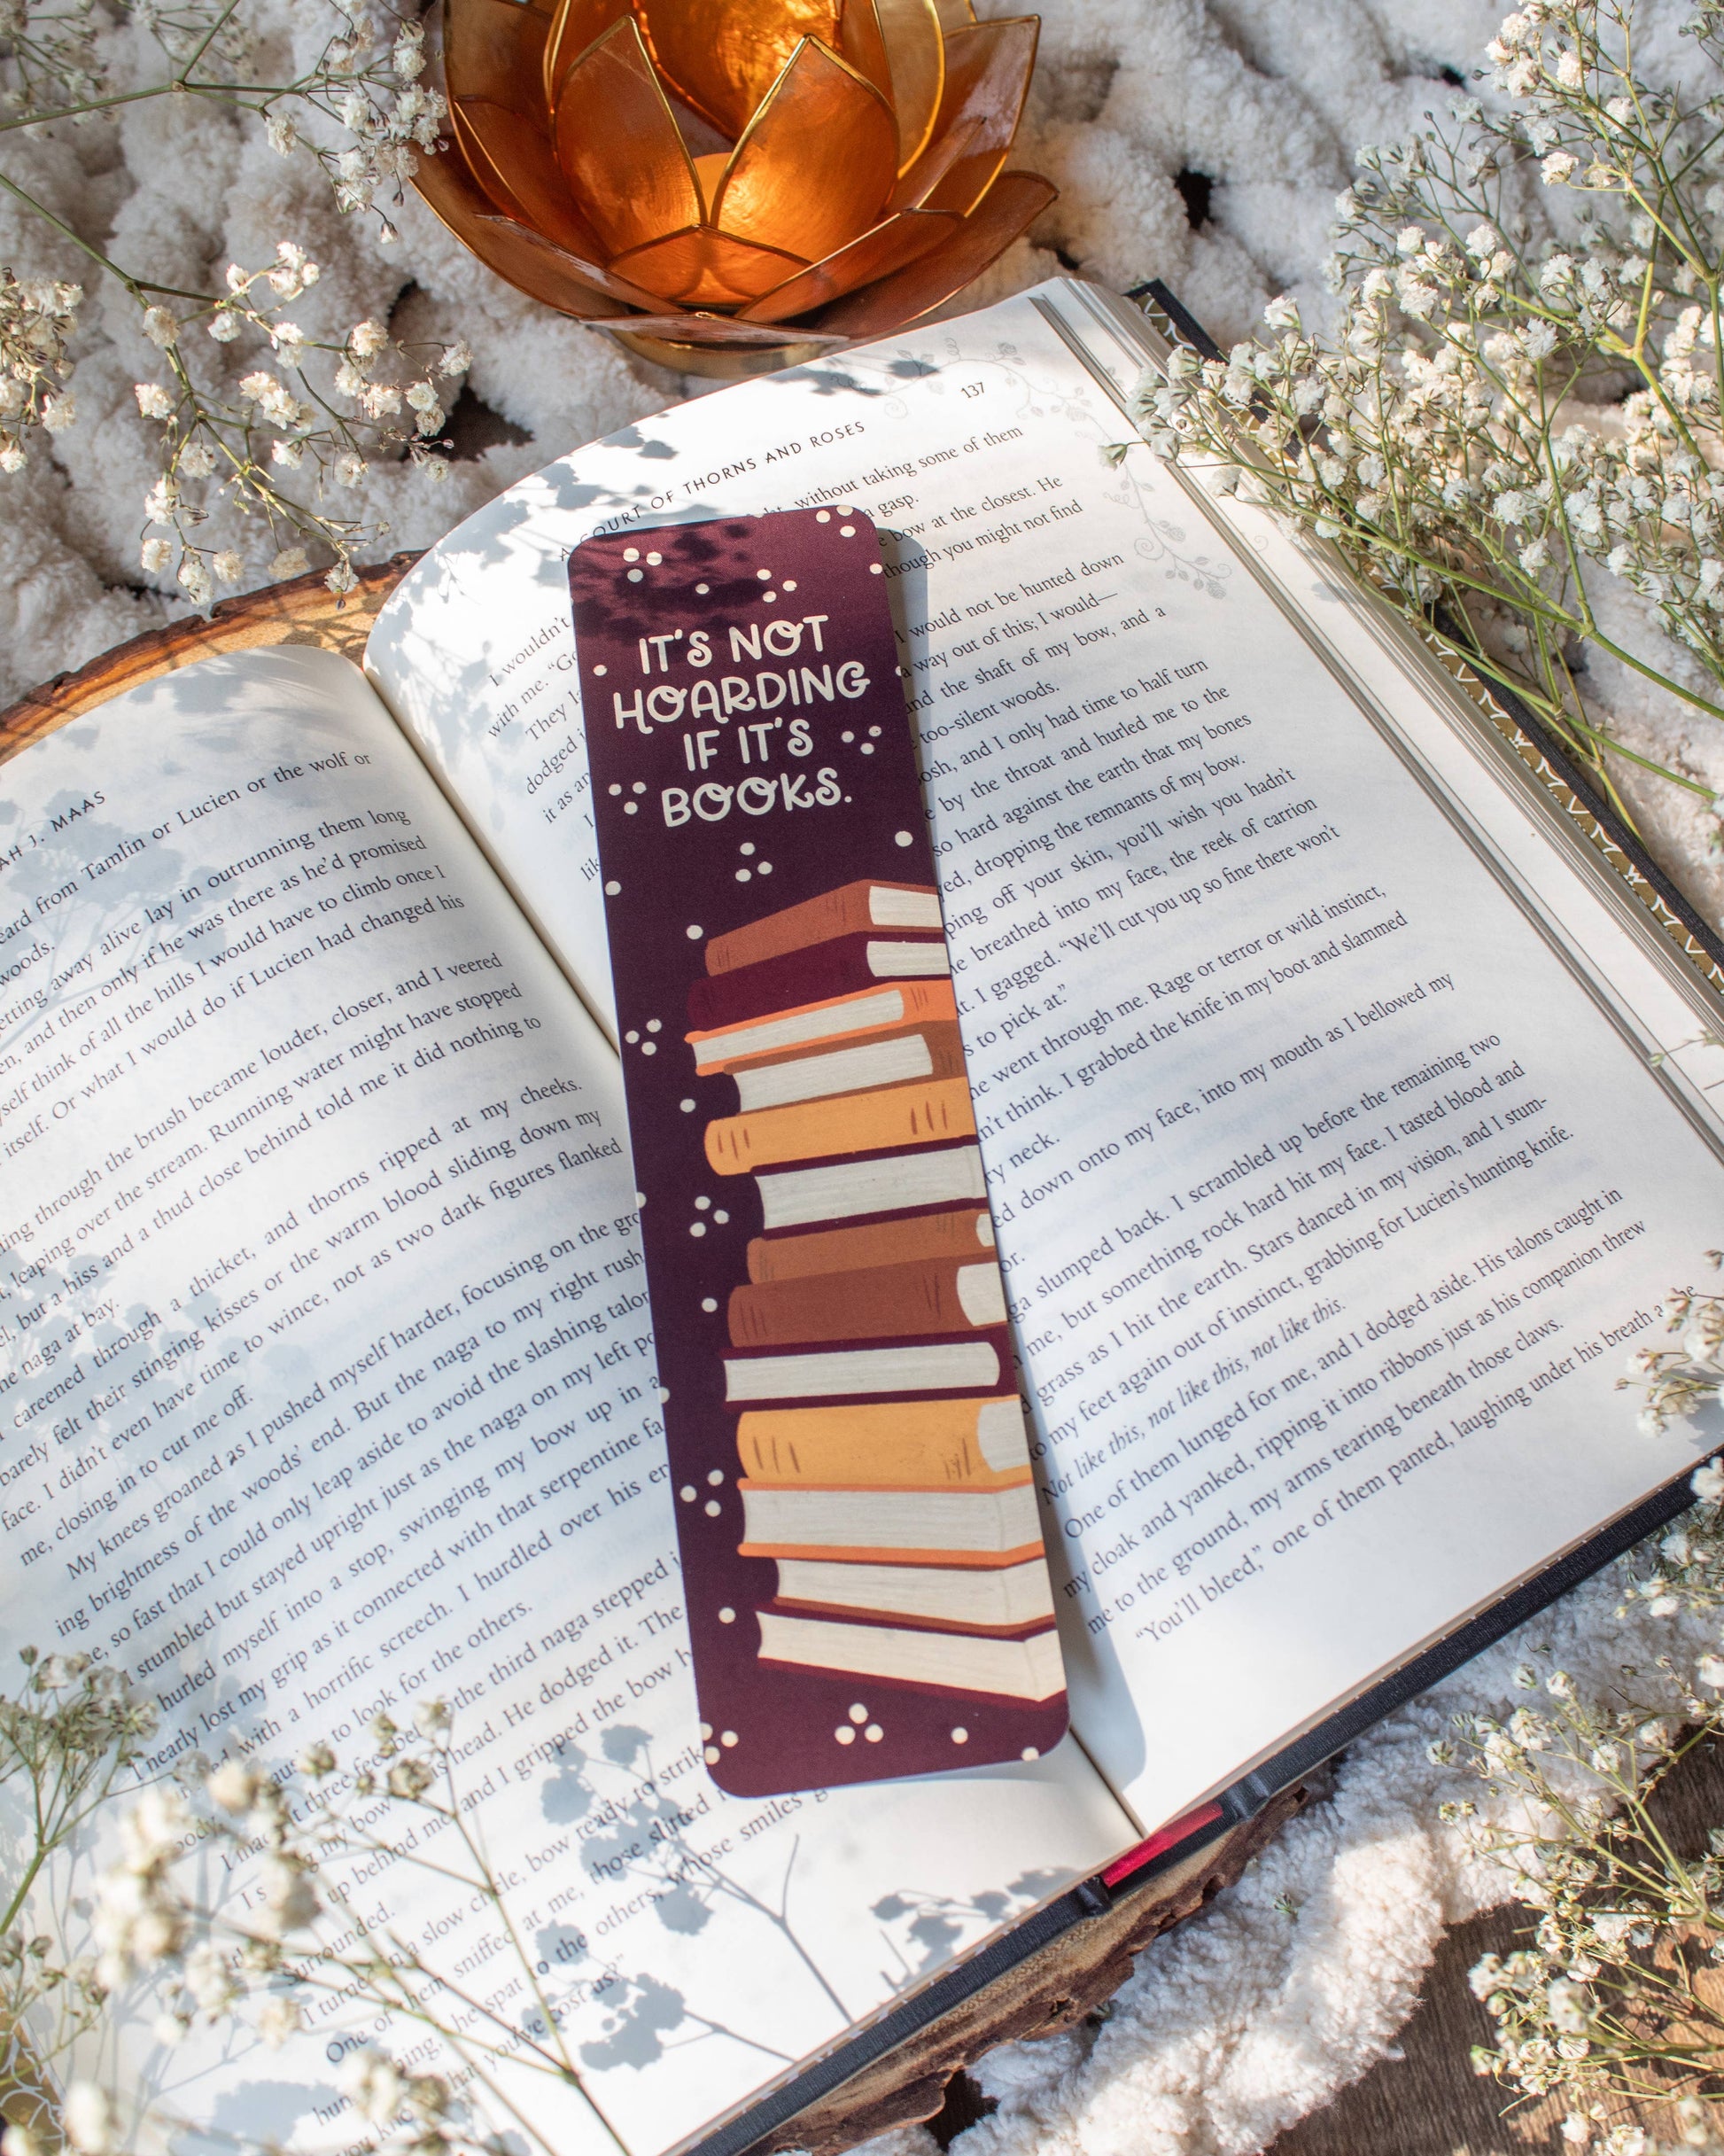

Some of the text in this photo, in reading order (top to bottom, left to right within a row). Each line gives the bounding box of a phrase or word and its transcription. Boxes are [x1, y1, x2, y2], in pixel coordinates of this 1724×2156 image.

[961, 382, 984, 398] 137
[650, 490, 674, 510] OF
[683, 458, 756, 494] THORNS
[765, 443, 801, 463] AND
[810, 422, 864, 447] ROSES
[794, 480, 859, 510] without
[862, 463, 917, 485] taking
[919, 448, 959, 467] some
[964, 437, 980, 453] of
[983, 428, 1023, 446] them
[878, 495, 919, 517] gasp.
[883, 499, 1083, 579] though you might not find
[888, 478, 1062, 541] bow at the closest. He
[489, 616, 571, 687] I wouldn't
[639, 615, 828, 674] IT'S NOT
[901, 666, 912, 678] a
[912, 652, 948, 671] way
[952, 640, 981, 657] out
[982, 627, 1000, 645] of
[1002, 619, 1038, 638] this;
[1036, 611, 1049, 625] I
[489, 681, 548, 736] with me.
[525, 704, 566, 740] They
[613, 661, 871, 734] HOARDING
[920, 681, 1060, 743] too-silent woods.
[960, 661, 1208, 765] and I only had time to half turn
[527, 736, 578, 794] dodged
[683, 717, 813, 771] IF IT'S
[28, 791, 105, 847] J. MAAS
[662, 767, 852, 827] BOOKS.
[933, 715, 1251, 857] so hard against the earth that my bones
[36, 751, 371, 915] from Tamlin or Lucien or the wolf or
[993, 768, 1296, 908] off your skin, you'll wish you hadn't
[992, 886, 1386, 1082] went through me. Rage or terror or wild instinct,
[35, 953, 503, 1225] through the brush became louder, closer, and I veered
[66, 1225, 610, 1580] My knees groaned as I pushed myself harder, focusing on the
[1042, 1298, 1346, 1505] Not like this, not like this, not like this.
[1065, 1190, 1623, 1537] One of them lunged for me, and I dodged aside. His talons caught in
[1273, 1525, 1309, 1553] one
[1313, 1499, 1334, 1527] of
[1337, 1476, 1386, 1511] them
[1387, 1430, 1454, 1485] panted,
[1450, 1388, 1532, 1438] laughing
[1529, 1358, 1575, 1391] under
[1573, 1342, 1603, 1363] his
[1599, 1311, 1653, 1347] breath
[131, 1434, 641, 1781] I nearly lost my grip as it connected with that serpentine
[547, 1792, 711, 1914] me, those slitted
[555, 1794, 804, 1963] the others, whose smiles
[326, 2011, 396, 2065] One of
